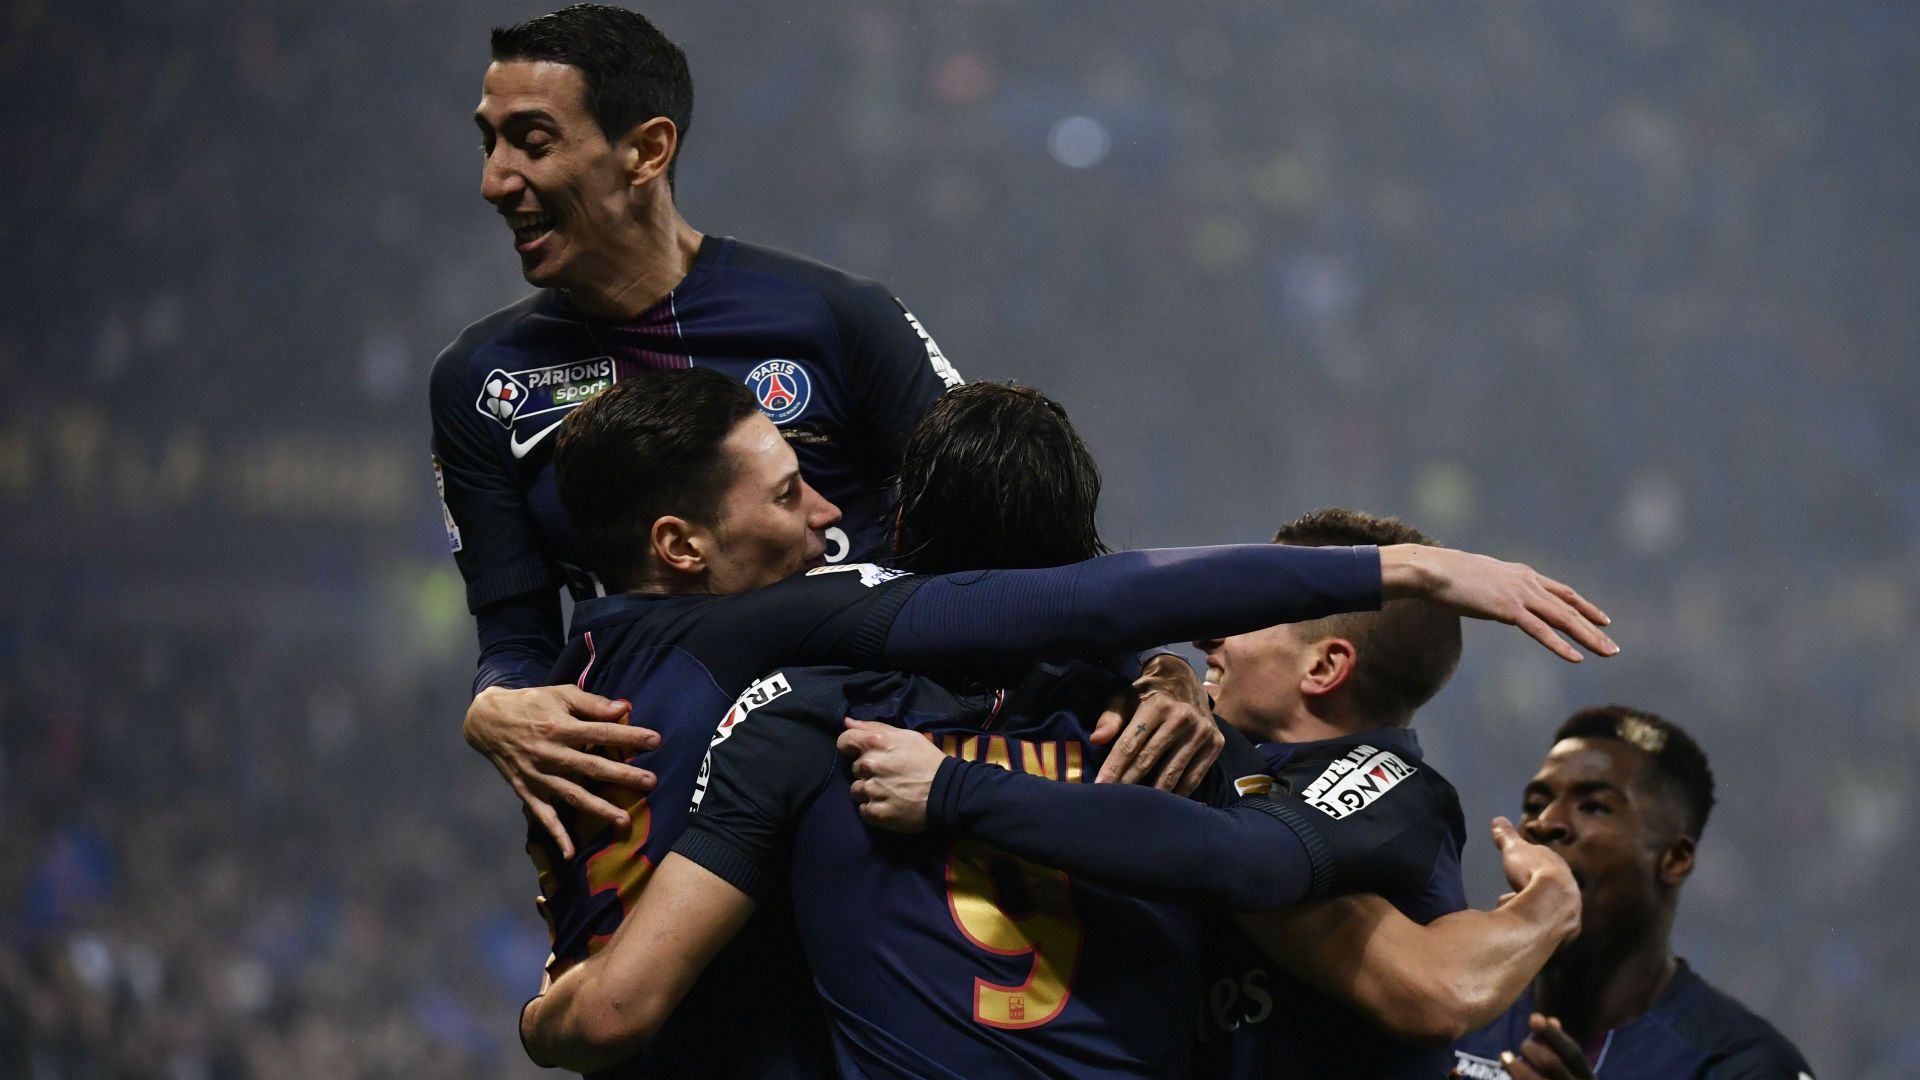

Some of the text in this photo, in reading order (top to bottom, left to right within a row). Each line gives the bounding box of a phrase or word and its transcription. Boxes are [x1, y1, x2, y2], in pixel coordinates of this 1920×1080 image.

[528, 360, 610, 389] PARIONS
[751, 362, 796, 382] PARIS
[556, 379, 607, 401] sport
[945, 840, 1084, 1030] 9
